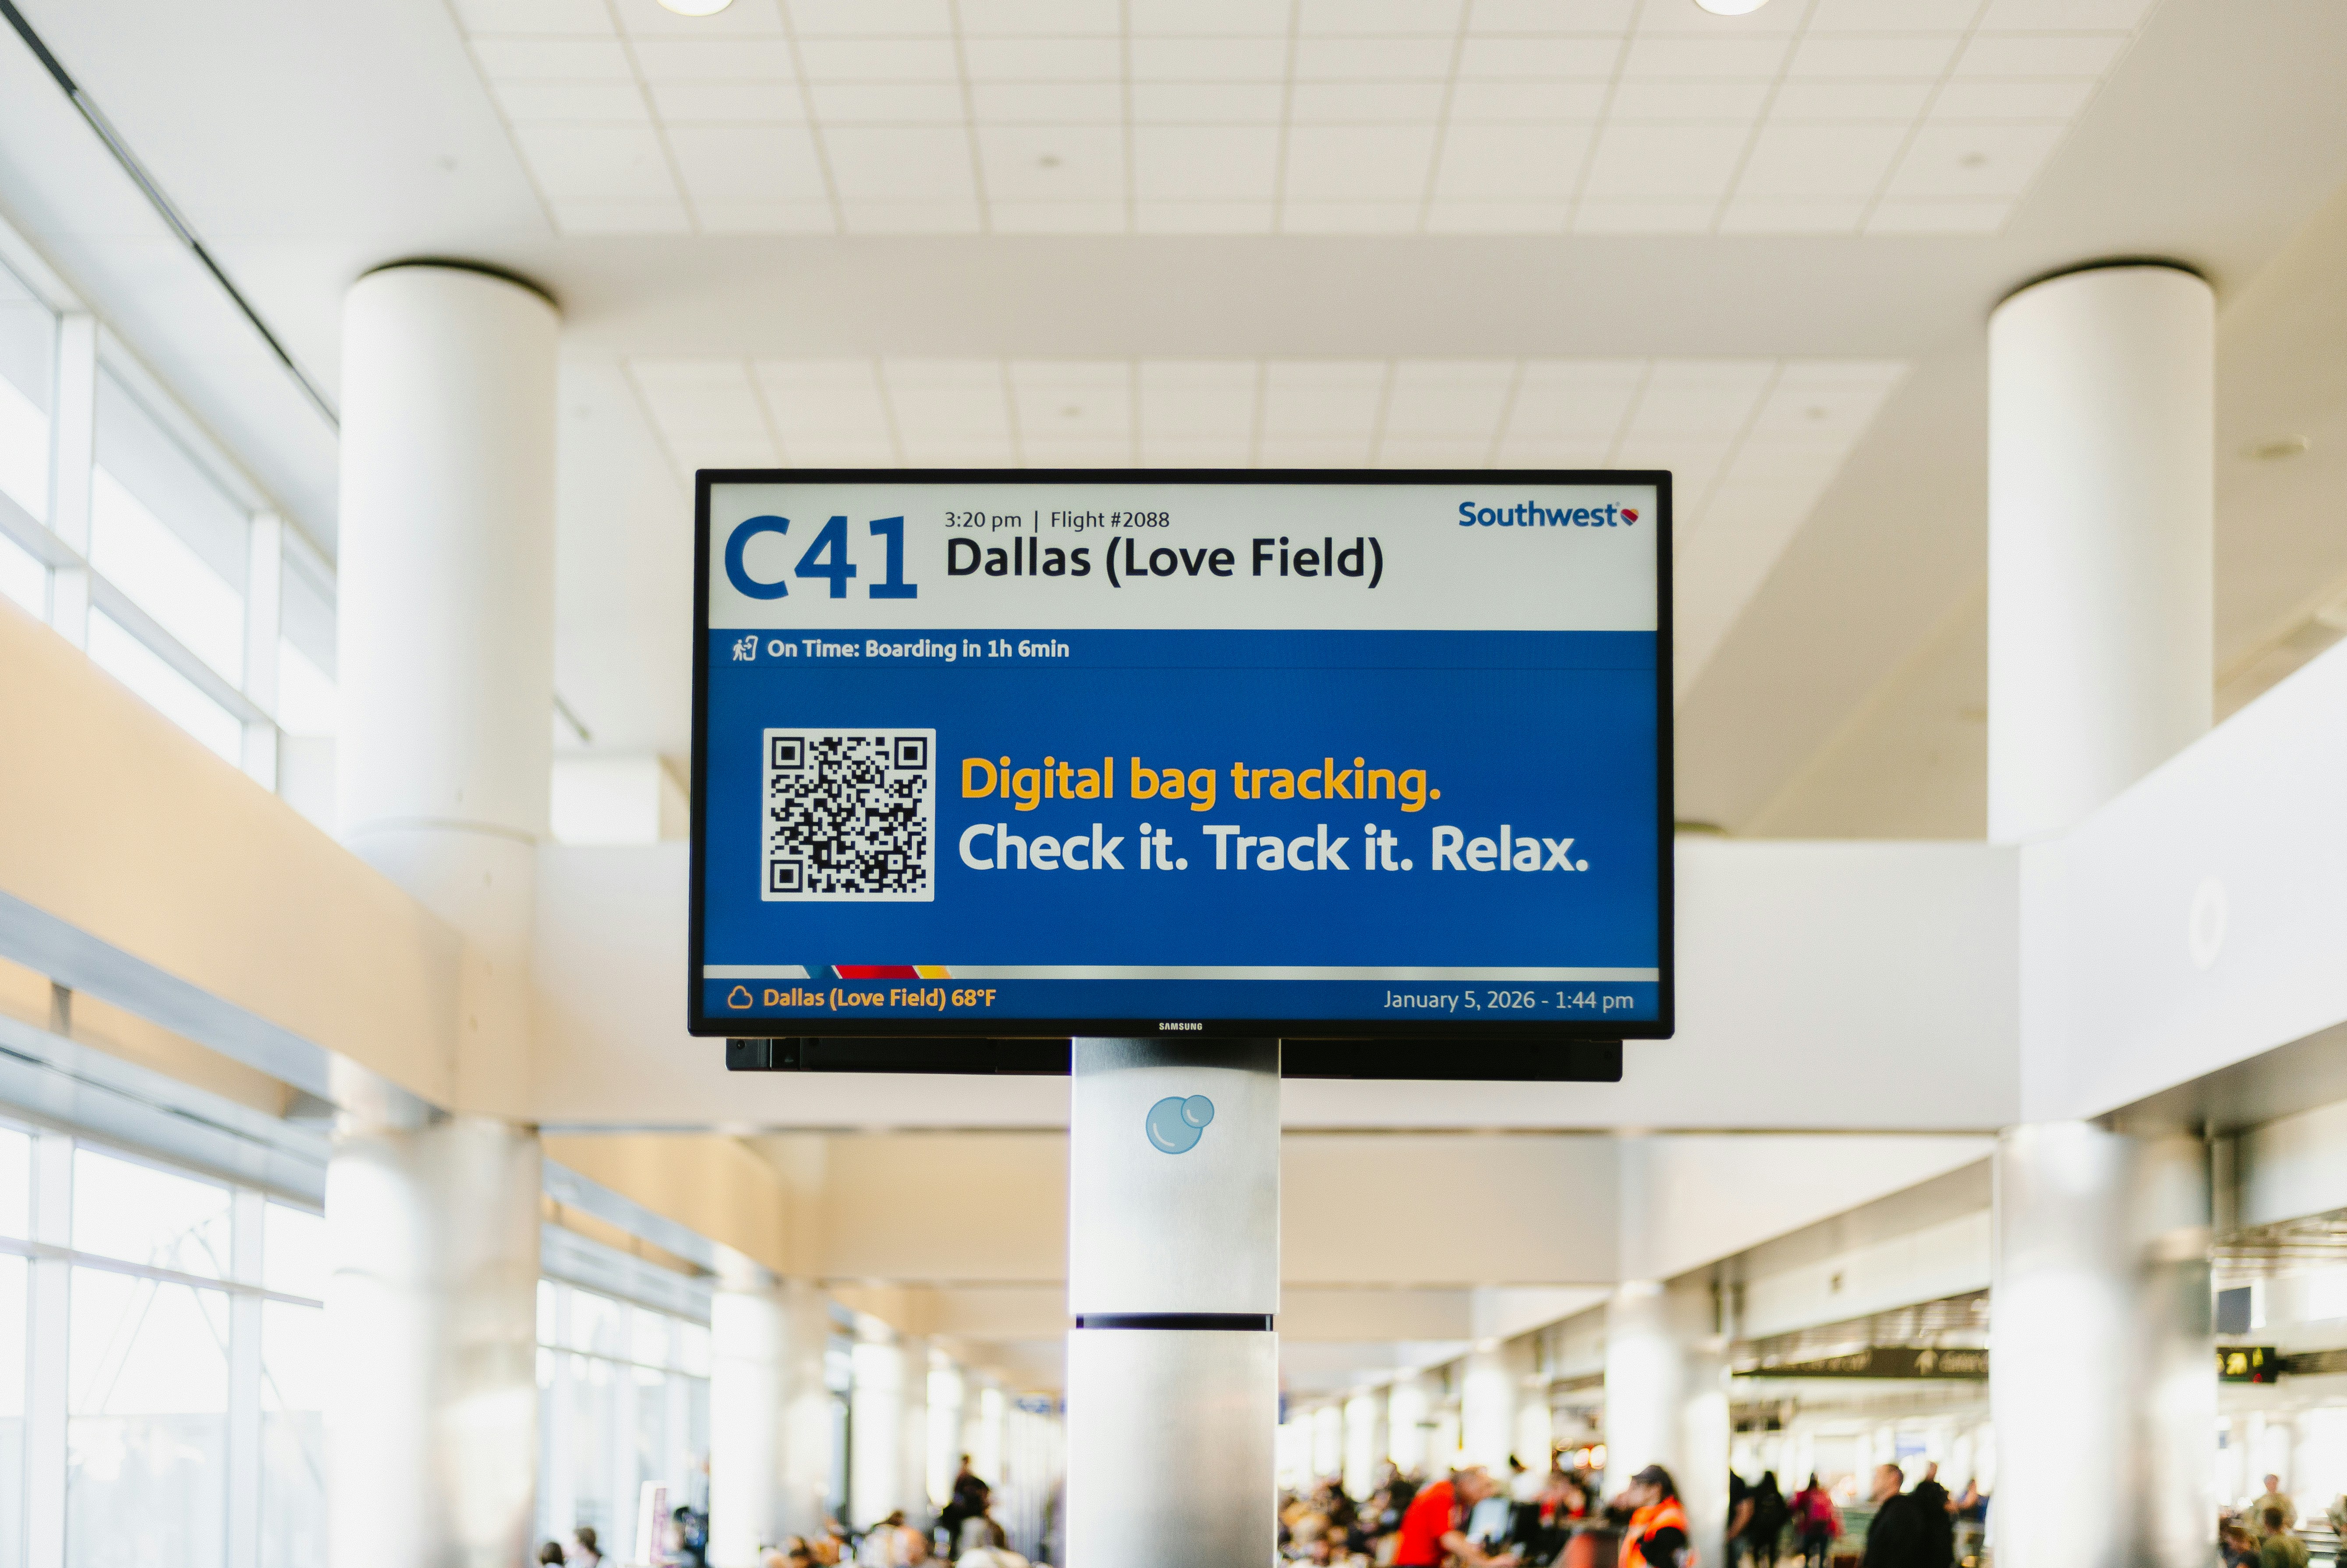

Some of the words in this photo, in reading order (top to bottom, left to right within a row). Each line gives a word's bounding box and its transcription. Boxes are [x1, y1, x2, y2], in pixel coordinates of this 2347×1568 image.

[945, 512, 986, 527] 3:20
[992, 516, 1022, 532] pm
[1051, 511, 1104, 532] Flight
[1111, 512, 1170, 527] #2088
[1459, 500, 1617, 527] Southwest
[725, 515, 918, 600] C41
[948, 536, 1091, 577] Dallas
[1106, 536, 1235, 588] (Love
[1252, 536, 1384, 589] Field)
[768, 640, 797, 657] On
[802, 639, 860, 657] Time:
[866, 639, 956, 662] Boarding
[963, 639, 981, 657] in
[988, 639, 1012, 657] 1h
[1018, 639, 1069, 657] 6min
[962, 756, 1113, 811] Digital
[1130, 757, 1216, 812] bag
[1230, 757, 1441, 812] tracking.
[959, 823, 1125, 870] Check
[1139, 822, 1188, 871] it.
[1203, 824, 1350, 871] Track
[1364, 823, 1413, 871] it.
[1432, 825, 1589, 872] Relax.
[764, 988, 825, 1006] Dallas
[830, 988, 884, 1011] (Love
[890, 988, 946, 1011] Field)
[952, 989, 996, 1006] 68°F
[1384, 991, 1459, 1013] January
[1464, 991, 1481, 1011] 5,
[1487, 991, 1535, 1008] 2026
[1556, 991, 1597, 1009] 1:44
[1603, 996, 1634, 1013] pm
[1159, 1022, 1203, 1030] SAMSUNG
